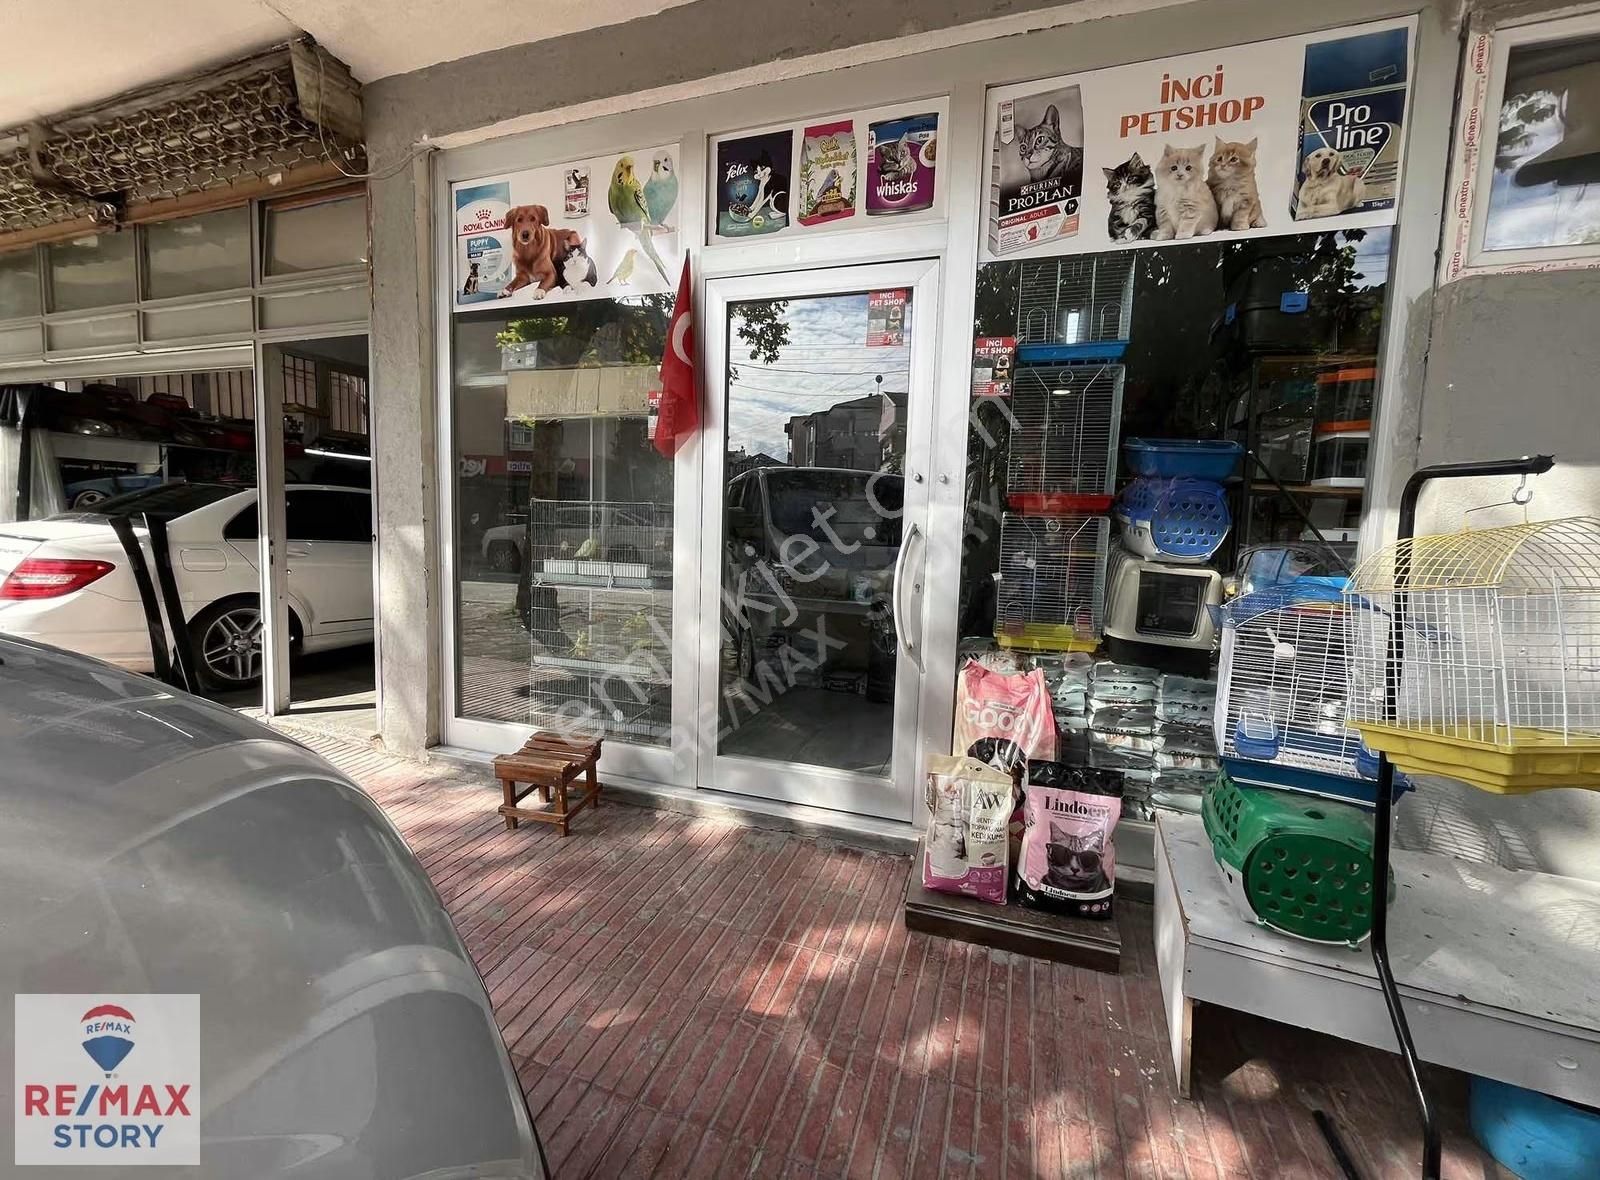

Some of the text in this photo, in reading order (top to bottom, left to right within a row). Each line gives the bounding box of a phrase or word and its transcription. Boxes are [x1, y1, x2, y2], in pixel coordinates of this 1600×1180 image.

[1120, 96, 1265, 138] PETSHOP
[1328, 103, 1371, 128] Pro
[1335, 126, 1383, 149] line
[876, 181, 918, 197] whiskas
[1029, 179, 1059, 192] PURINA
[1001, 209, 1048, 227] ORIGINAL ADULT
[463, 221, 484, 233] ROYAL
[883, 298, 905, 306] SHOP
